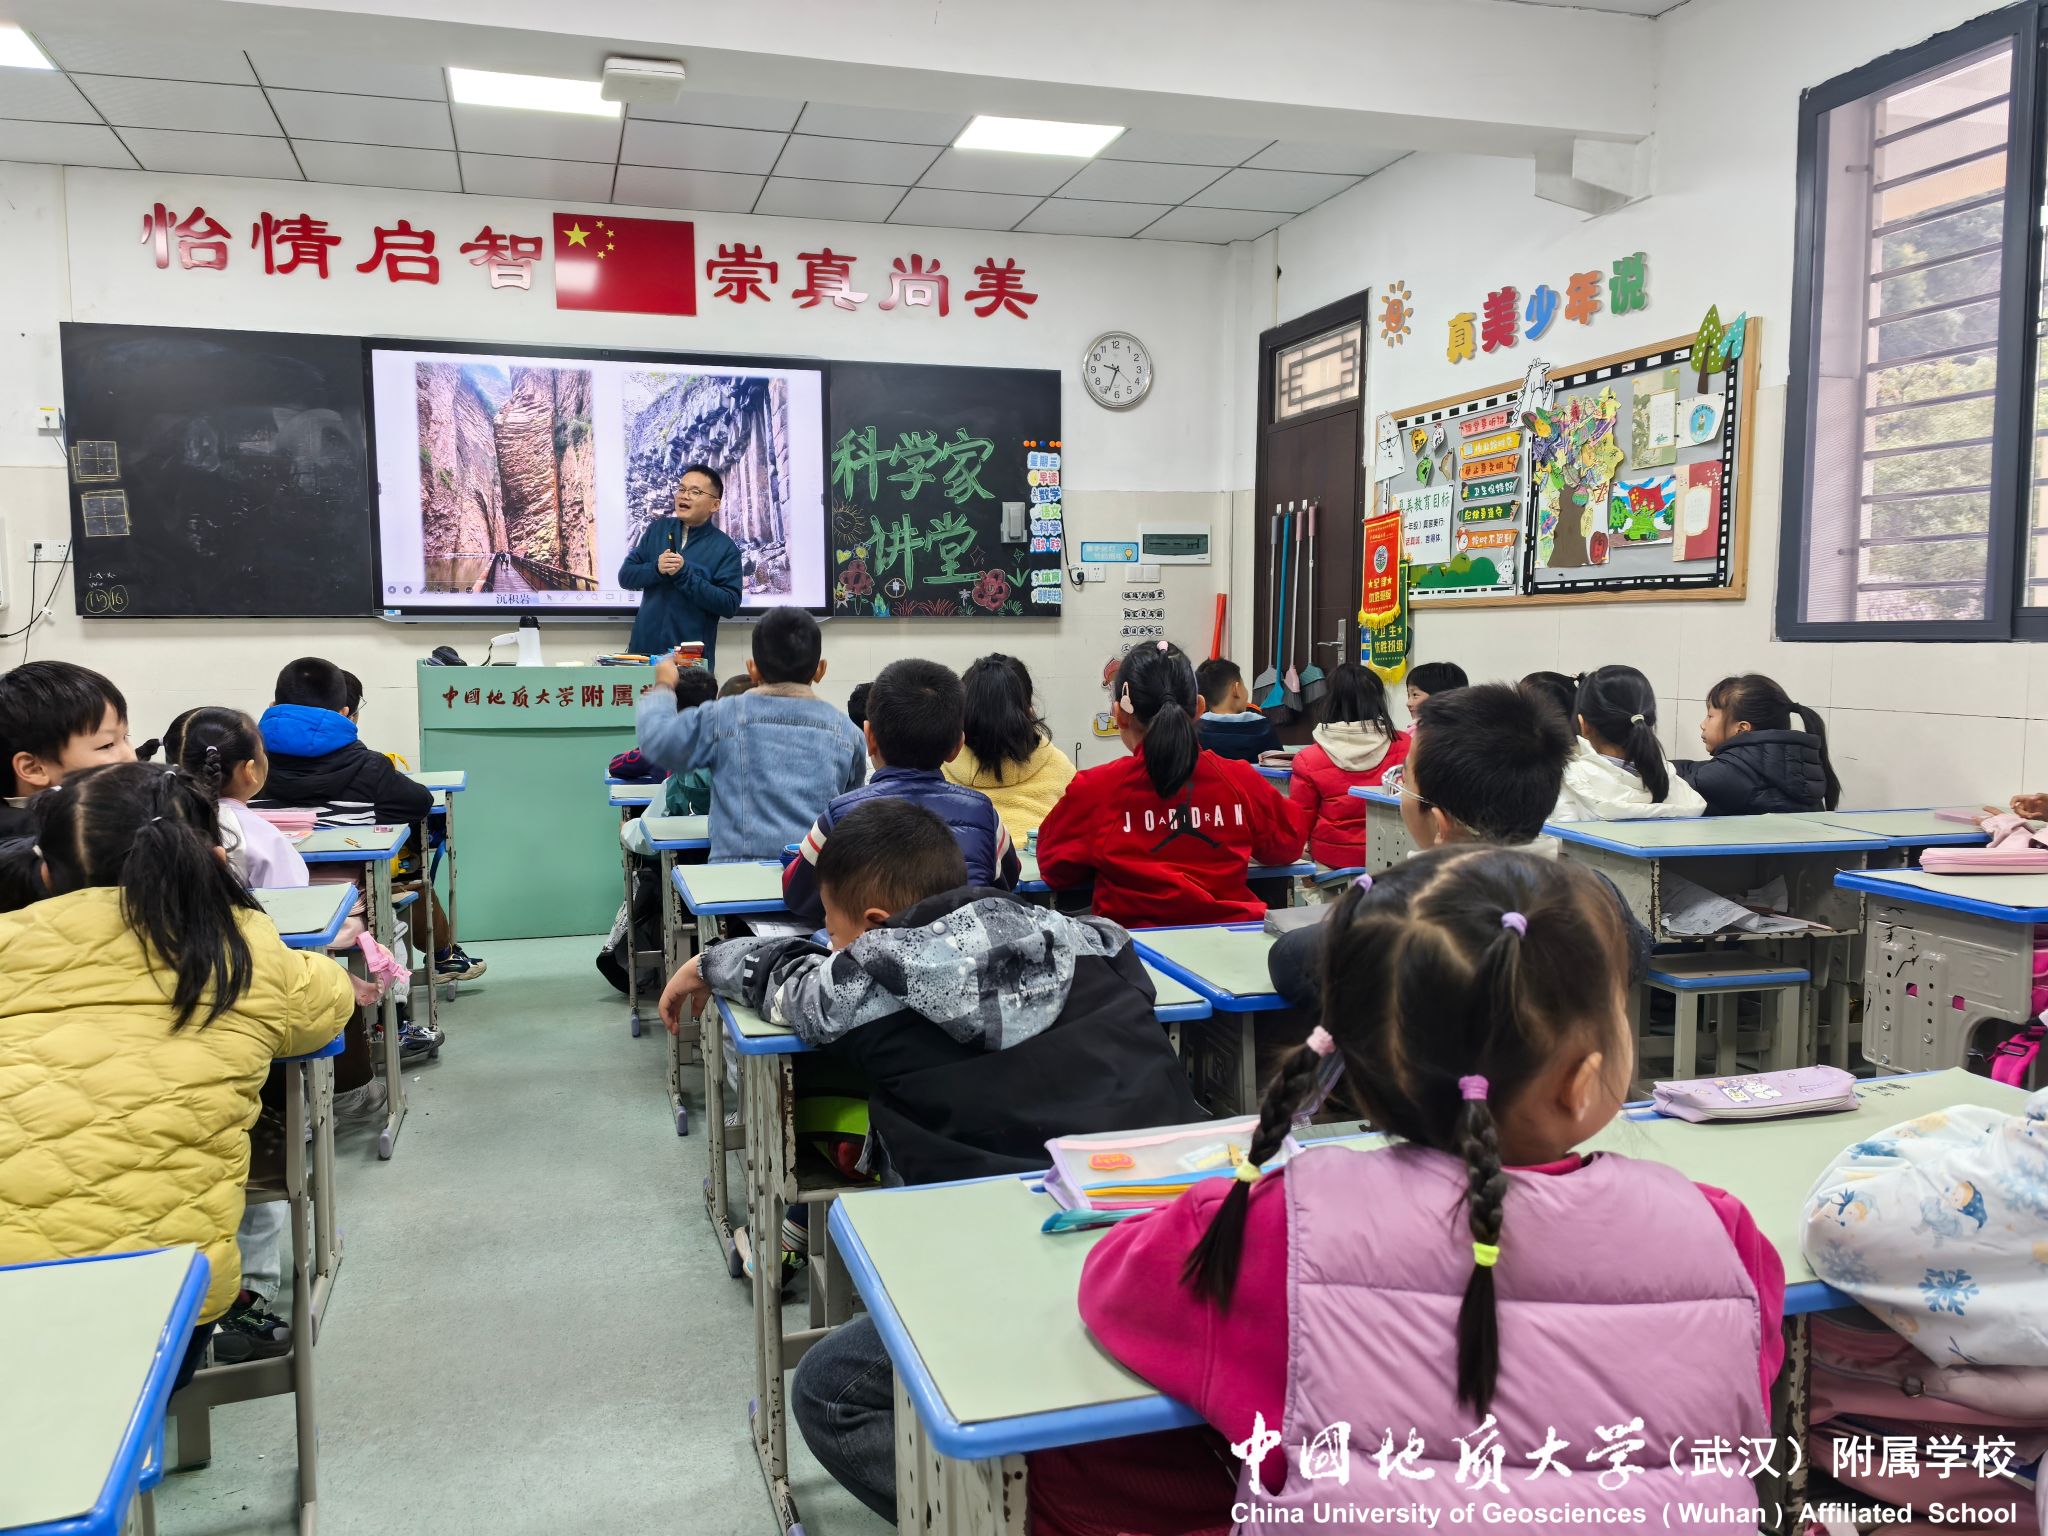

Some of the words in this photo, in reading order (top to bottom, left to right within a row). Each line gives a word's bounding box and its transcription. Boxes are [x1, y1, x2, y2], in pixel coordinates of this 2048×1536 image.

[141, 202, 543, 290] 怡情启智
[706, 242, 1039, 320] 崇真尚美
[1446, 251, 1649, 364] 真美少年说
[1100, 345, 1107, 354] 11
[1111, 340, 1120, 350] 12
[1126, 345, 1131, 354] 1
[1093, 353, 1101, 362] 10
[1133, 353, 1140, 362] 2
[1090, 365, 1097, 374] 9
[1136, 365, 1142, 374] 3
[1094, 377, 1101, 386] 8
[1134, 377, 1141, 386] 4
[1114, 391, 1120, 399] 6
[1126, 385, 1133, 395] 5
[832, 425, 996, 504] 科学家
[1038, 487, 1061, 501] 数学
[1474, 481, 1515, 497] 卫生保持好
[1041, 504, 1061, 519] 语文
[1039, 520, 1061, 535] 科学
[866, 512, 982, 591] 讲堂
[1041, 570, 1061, 585] 体育
[496, 593, 531, 605] 沉积岩
